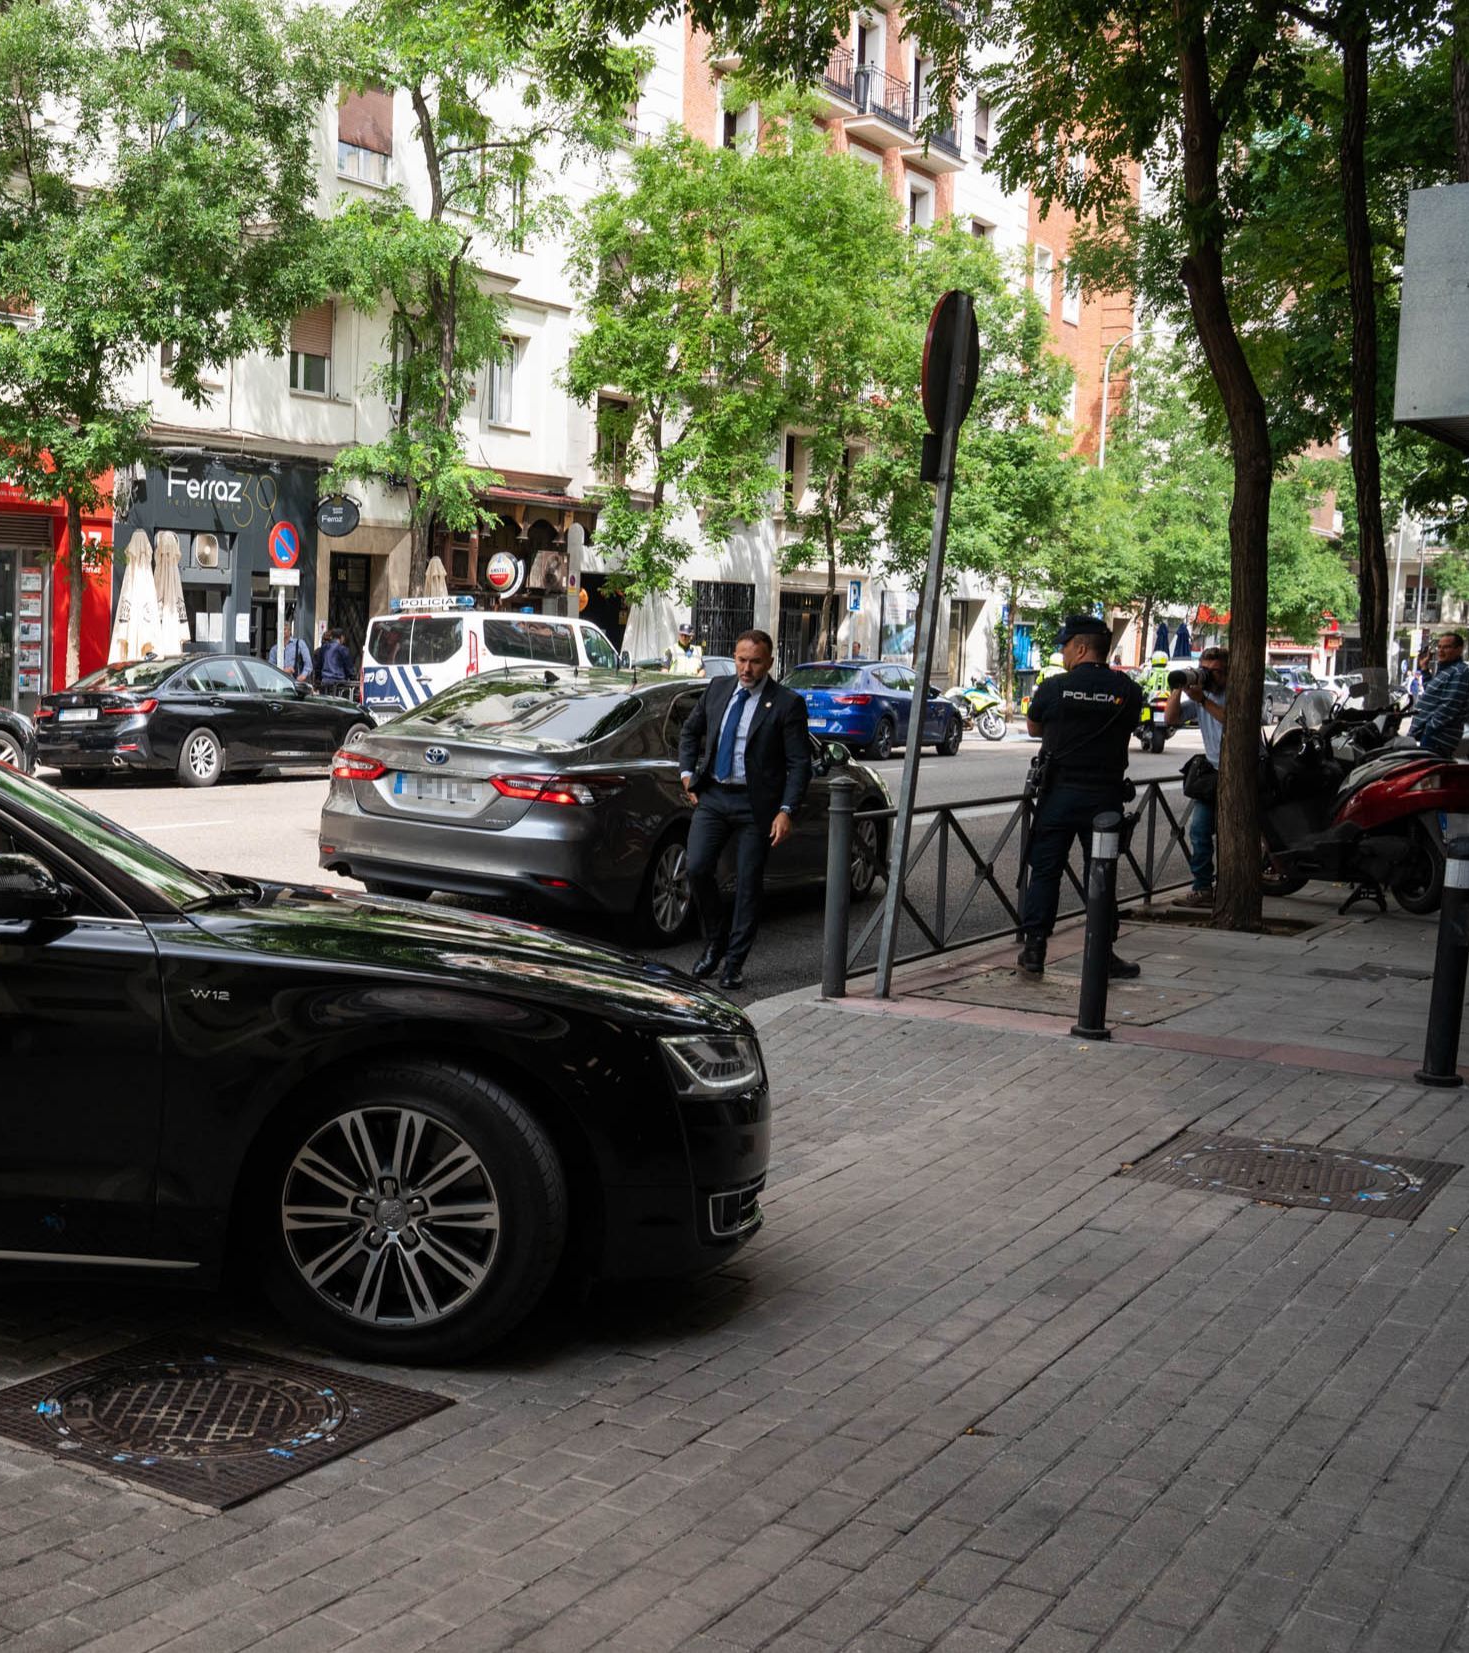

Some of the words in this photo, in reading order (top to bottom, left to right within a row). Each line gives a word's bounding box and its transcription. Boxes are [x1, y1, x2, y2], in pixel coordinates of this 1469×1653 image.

[167, 466, 242, 503] Ferraz
[232, 472, 278, 529] 39
[1062, 690, 1115, 703] POLICIA
[190, 988, 230, 1001] W12
